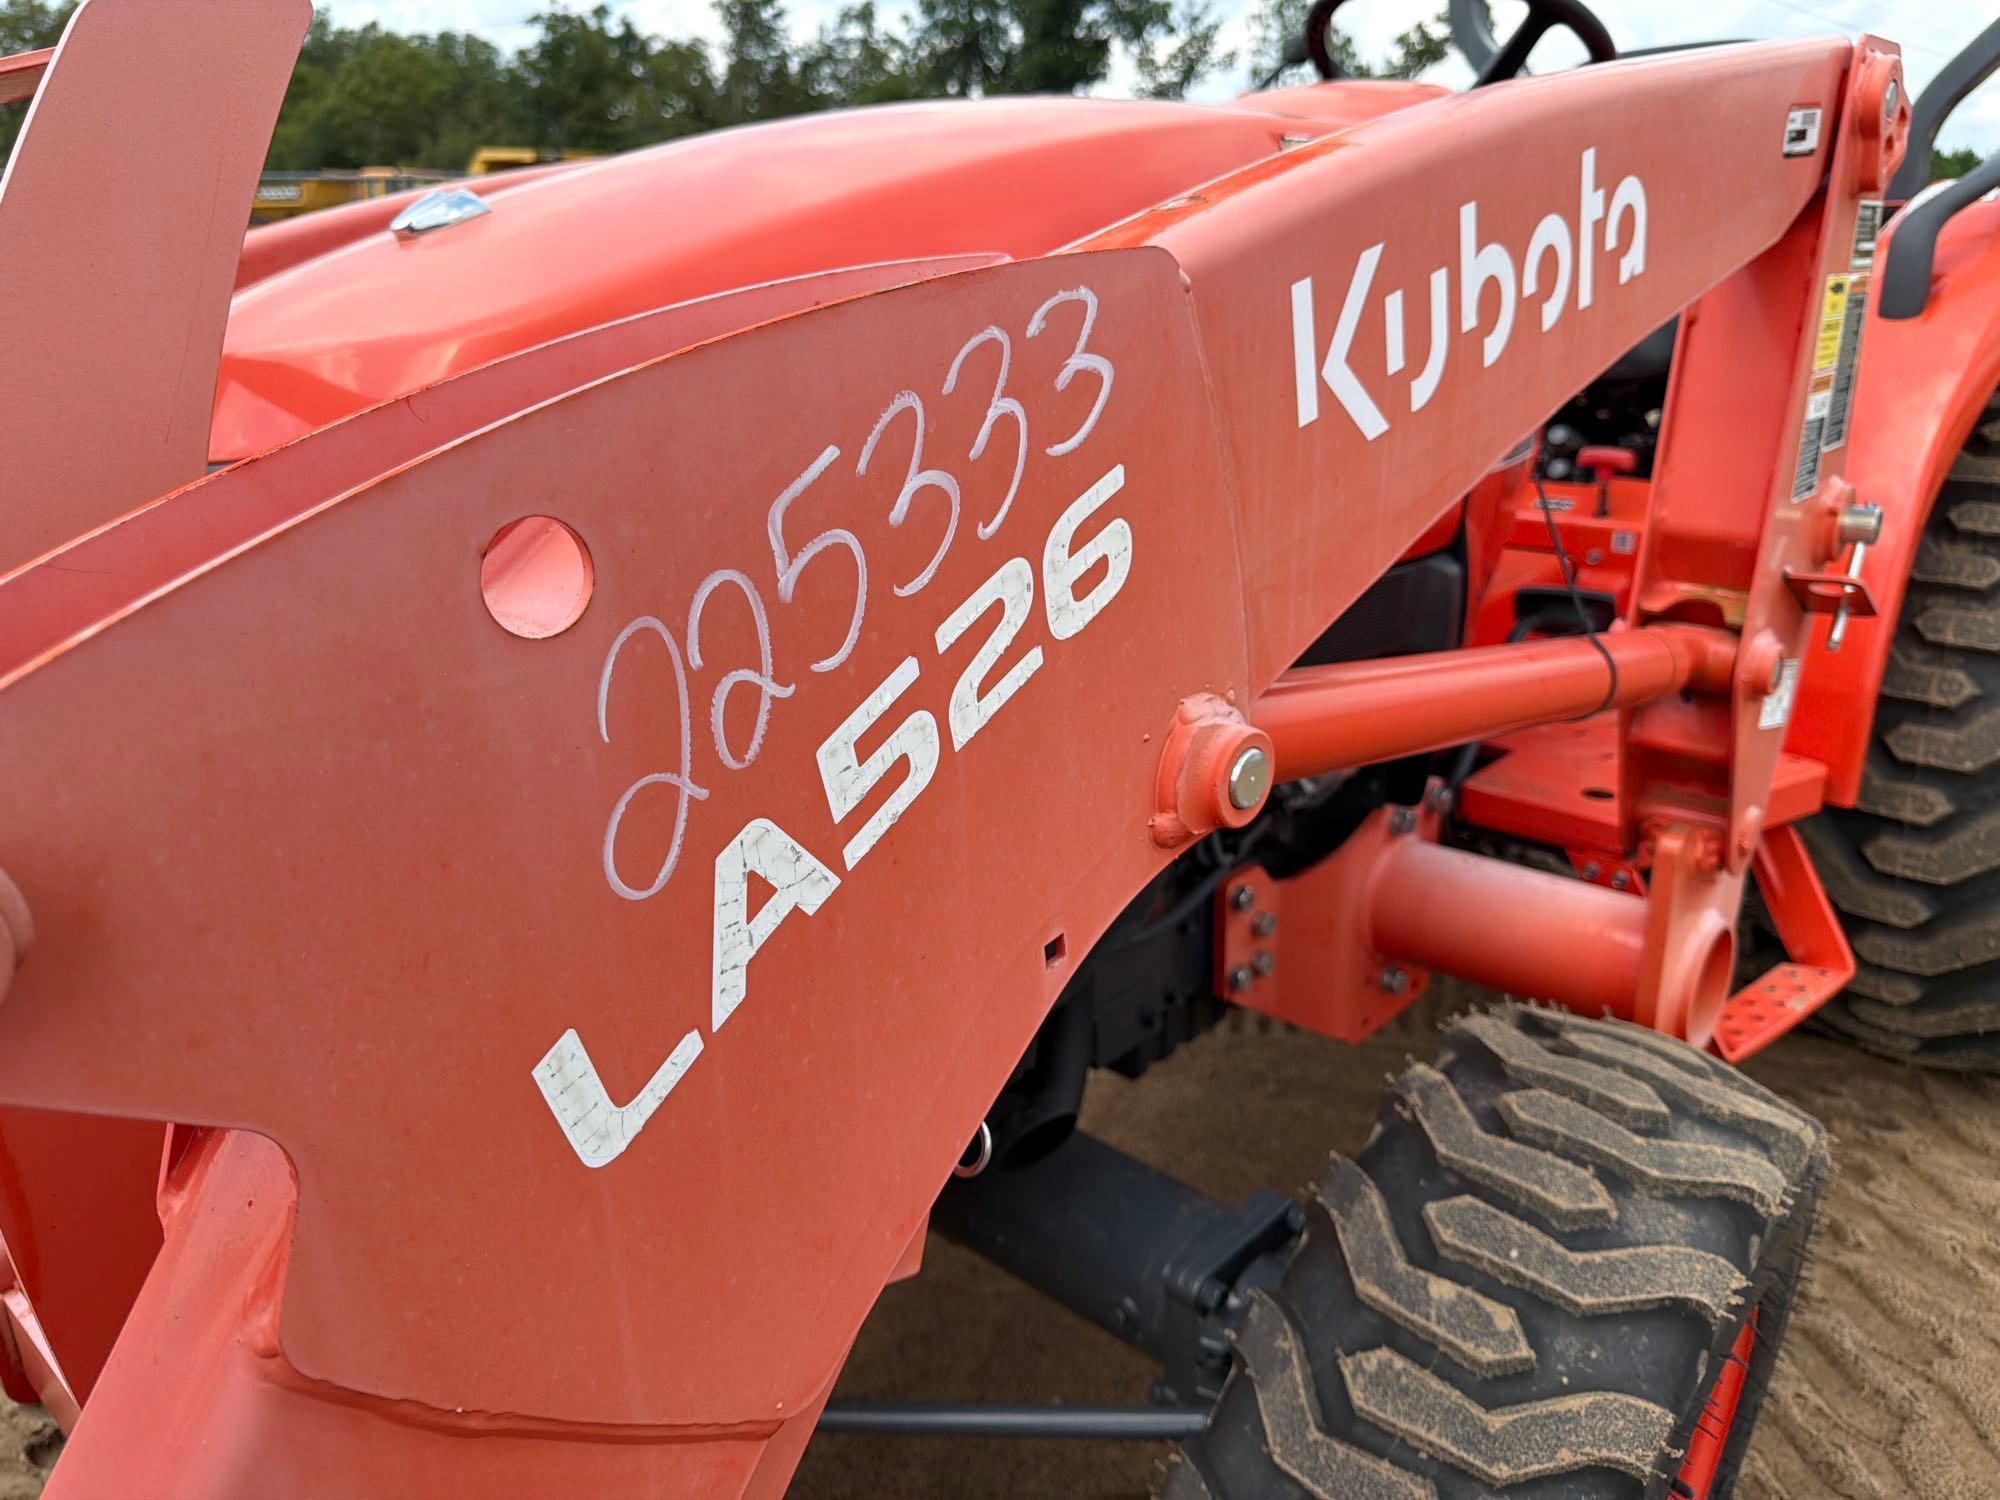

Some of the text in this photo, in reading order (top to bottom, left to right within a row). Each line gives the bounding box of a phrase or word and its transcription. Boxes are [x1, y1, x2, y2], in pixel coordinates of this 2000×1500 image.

[599, 285, 1114, 901] 225333
[1291, 147, 1647, 441] Kubota
[531, 464, 1133, 1169] LA526
